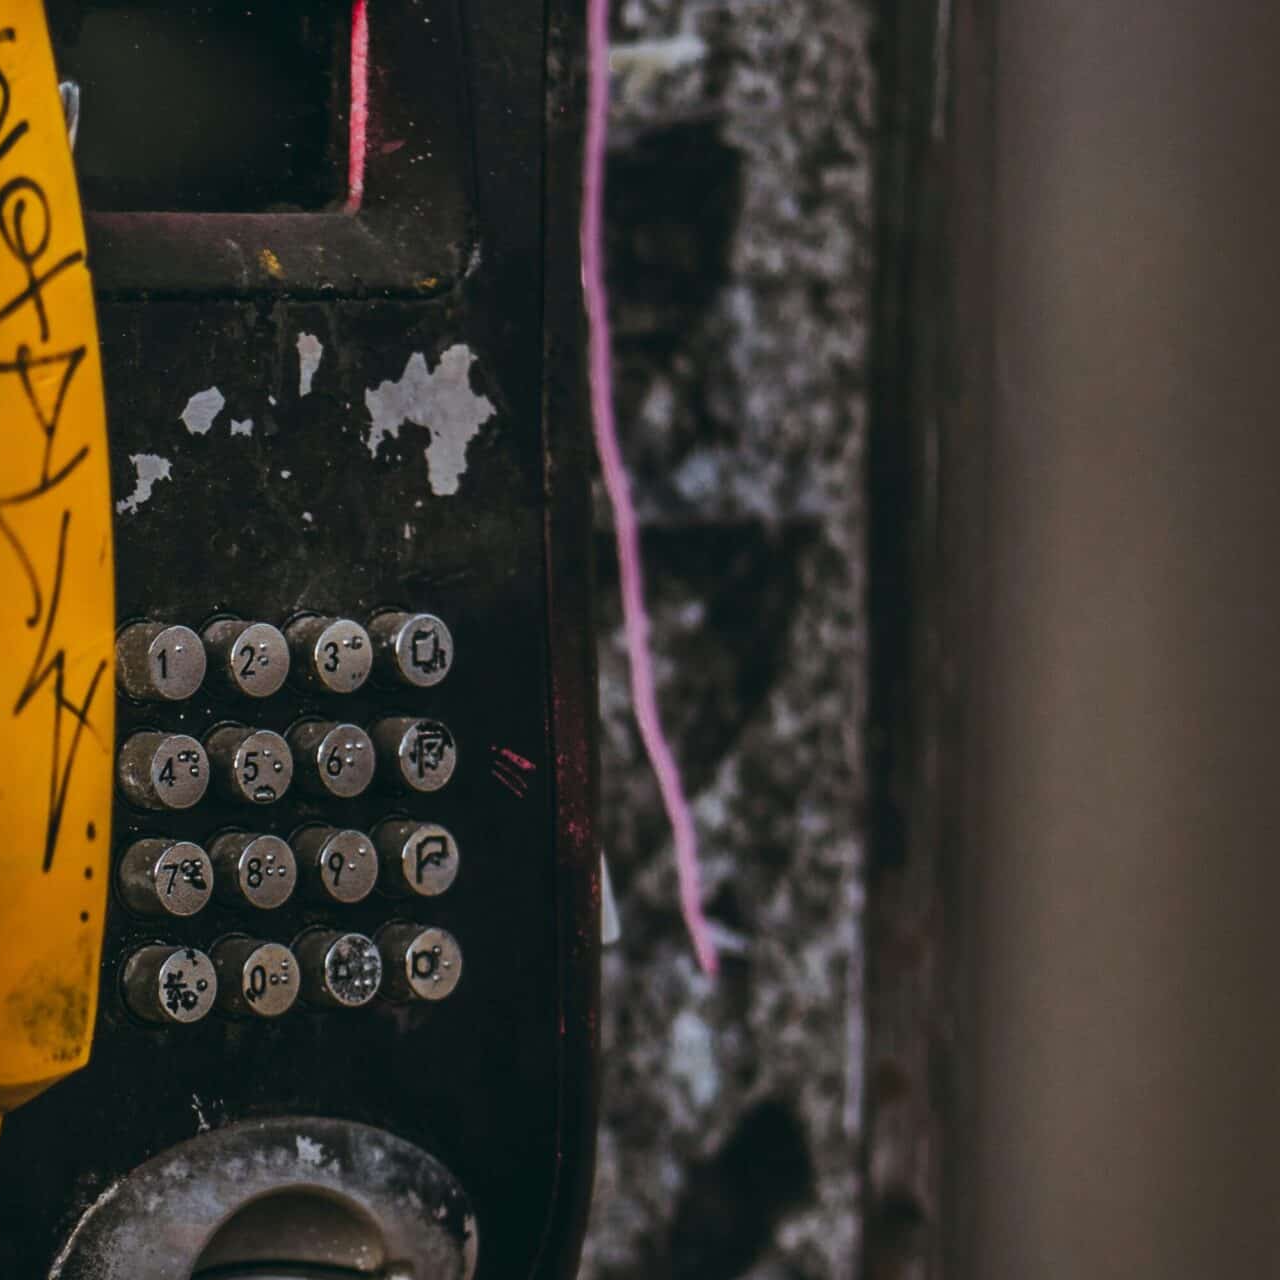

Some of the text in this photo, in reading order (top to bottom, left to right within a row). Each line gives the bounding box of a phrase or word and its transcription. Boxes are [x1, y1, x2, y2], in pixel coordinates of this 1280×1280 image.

[157, 648, 167, 679] 1
[239, 645, 256, 677] 2
[323, 641, 339, 673] 3
[158, 756, 176, 787] 4
[242, 751, 258, 784] 5
[326, 745, 342, 777] 6
[162, 863, 178, 896] 7
[246, 857, 263, 889] 8
[327, 852, 344, 887] 9
